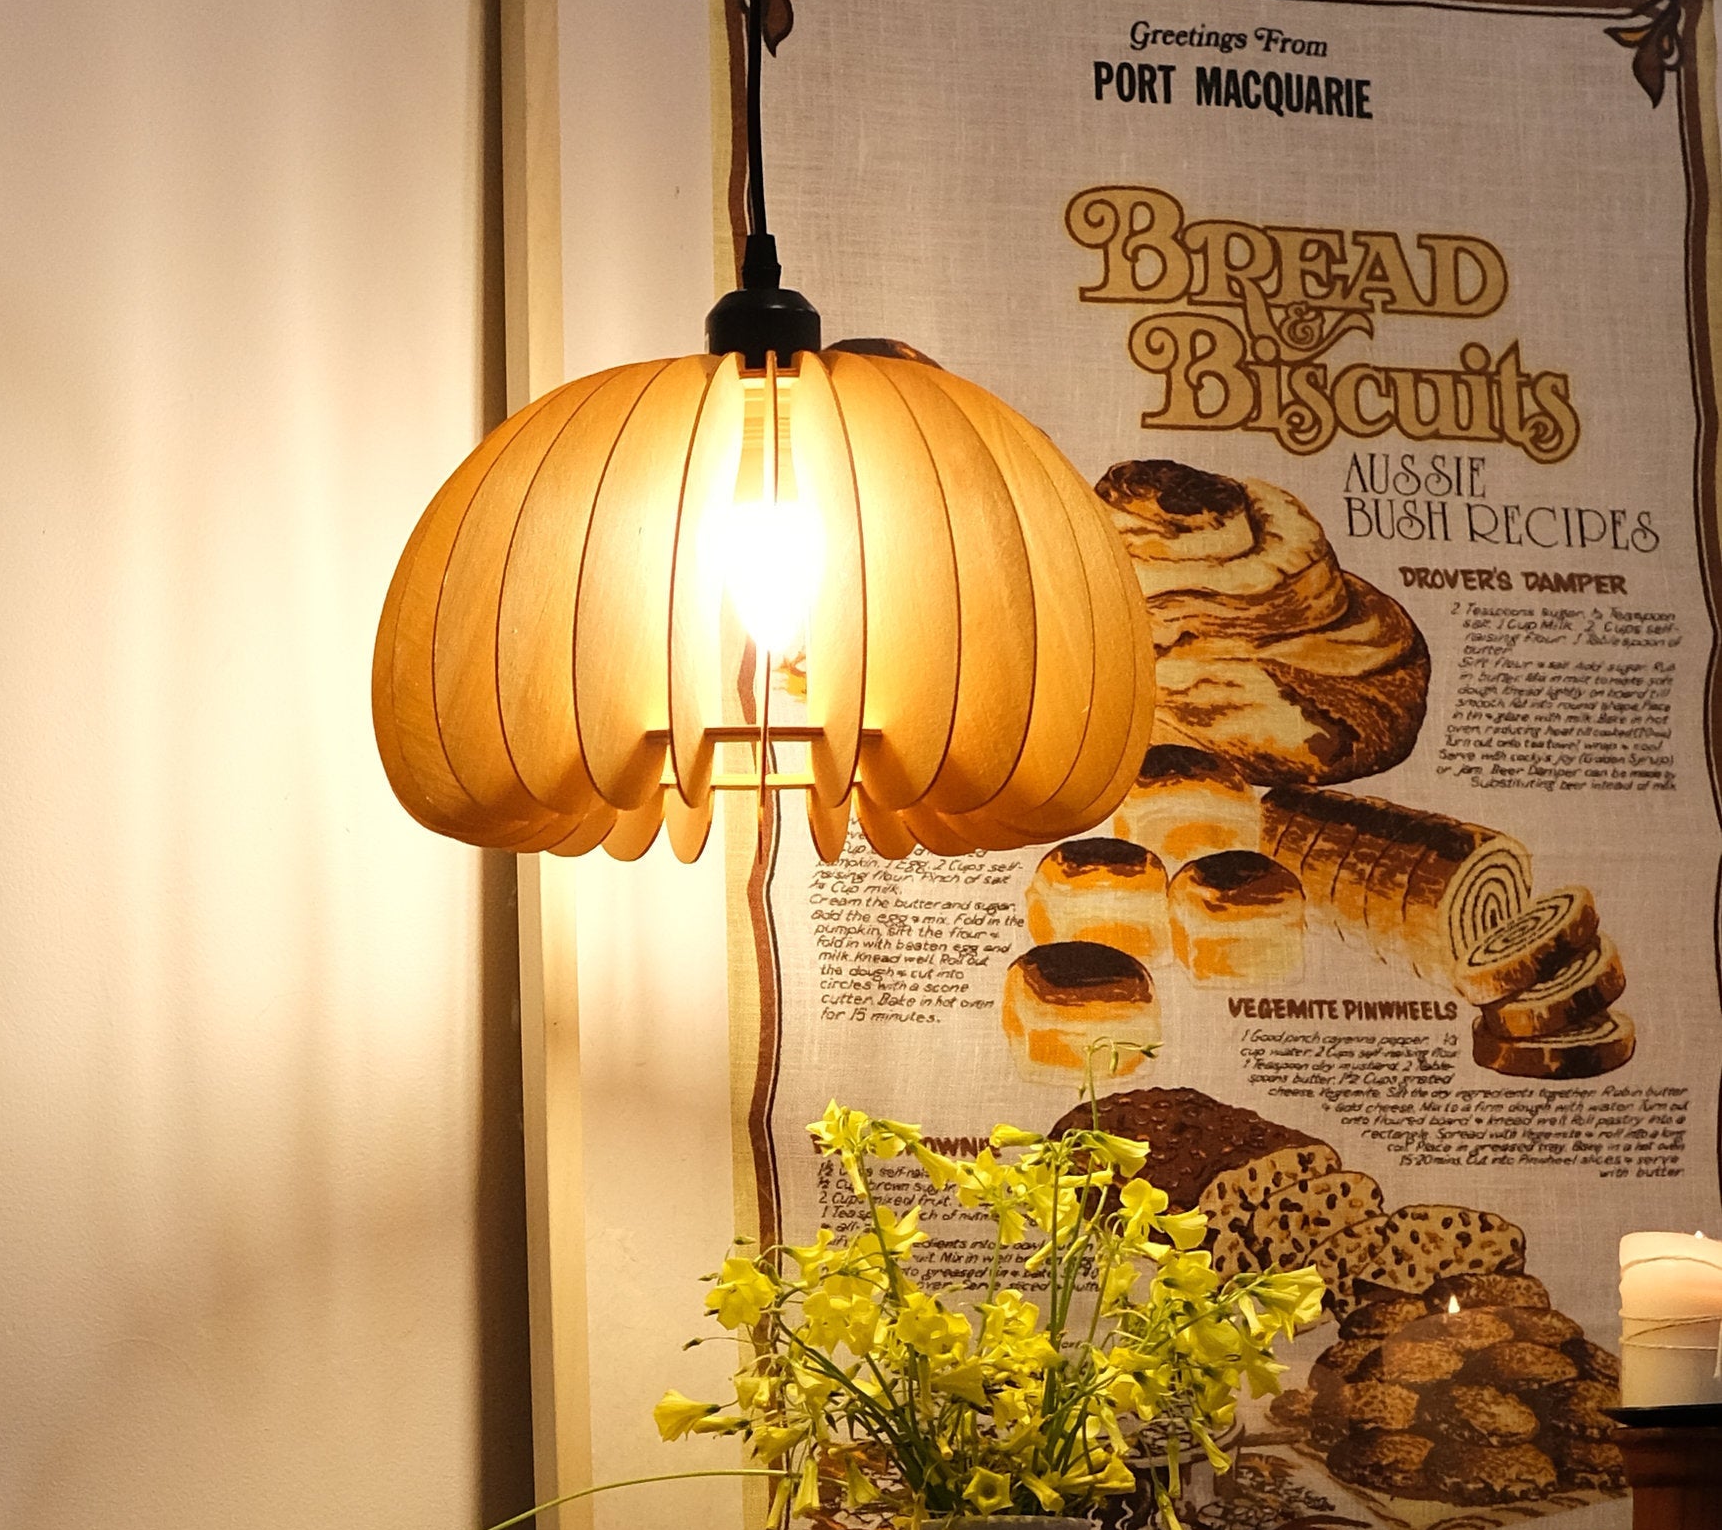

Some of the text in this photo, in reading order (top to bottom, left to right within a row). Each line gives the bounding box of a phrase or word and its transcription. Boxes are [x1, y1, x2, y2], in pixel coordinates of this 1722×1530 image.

[1130, 20, 1328, 57] Greetings From
[1093, 61, 1373, 119] PORT MACQUARIE
[1065, 185, 1509, 350] BREAD
[1279, 302, 1327, 348] &
[1129, 312, 1580, 465] Biscuits
[1343, 452, 1488, 499] AUSSIE
[1346, 497, 1661, 554] BUSH RECIPES
[1398, 566, 1628, 595] DROVER'S DAMPER
[948, 860, 984, 873] Cups
[831, 883, 860, 896] Cup
[809, 894, 970, 911] Cream the butter and
[845, 911, 871, 922] the
[878, 914, 908, 927] egg
[953, 914, 985, 926] Fold
[987, 916, 1000, 927] in
[1004, 916, 1025, 928] the
[918, 926, 943, 939] the
[862, 940, 892, 951] with
[895, 940, 947, 952] beaten
[820, 964, 843, 976] the
[910, 968, 932, 980] cut
[820, 979, 871, 991] circles
[909, 983, 919, 991] a
[923, 982, 969, 993] scone
[878, 992, 915, 1006] Bake
[920, 996, 932, 1007] in
[935, 997, 954, 1008] hot
[820, 1007, 941, 1024] for 15 minutes.
[1228, 997, 1458, 1021] VEGEMITE PINWHEELS
[818, 1192, 828, 1205] 2
